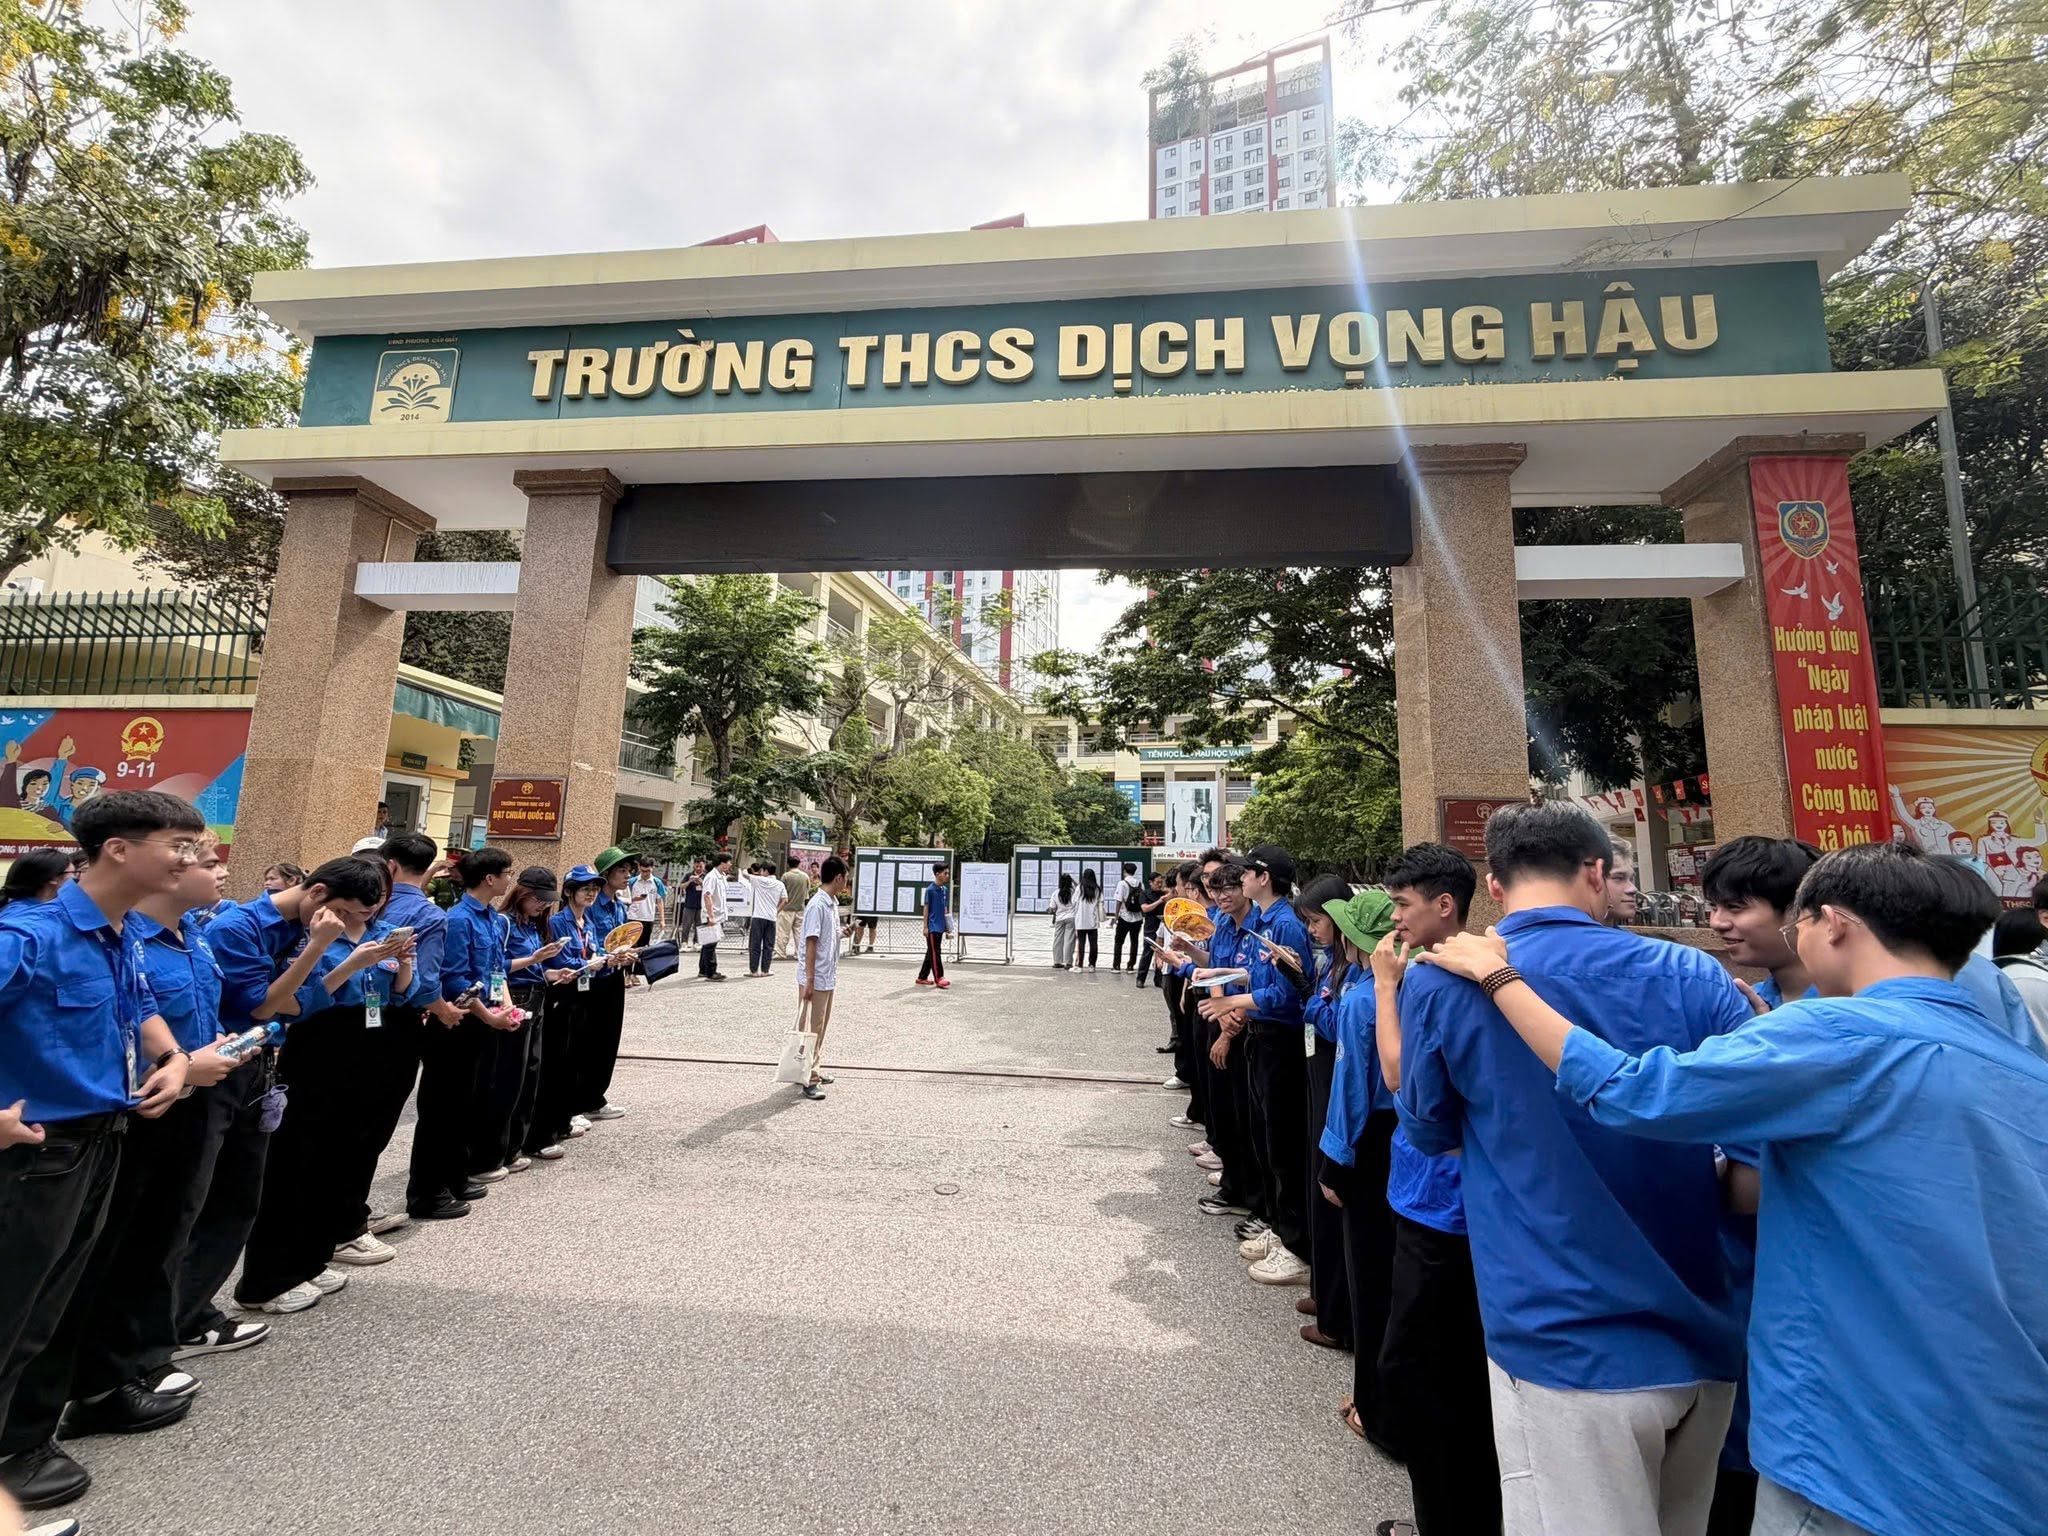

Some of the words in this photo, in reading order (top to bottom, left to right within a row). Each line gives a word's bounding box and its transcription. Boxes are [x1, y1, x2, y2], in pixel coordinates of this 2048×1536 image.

[527, 328, 814, 399] TRƯỜNG
[839, 327, 1035, 388] THCS
[1058, 317, 1245, 392] DỊCH
[1270, 305, 1505, 384] VỌNG
[1530, 281, 1719, 372] HẬU
[400, 413, 420, 421] 2014
[1774, 622, 1826, 655] Hưởng
[1830, 625, 1859, 655] ứng
[1792, 703, 1834, 732] pháp
[1837, 702, 1869, 736] luật
[116, 761, 156, 778] 9-11
[1814, 743, 1858, 770] nước
[1801, 783, 1845, 816] Cộng
[1848, 783, 1879, 811] hòa
[1817, 824, 1839, 852] xã
